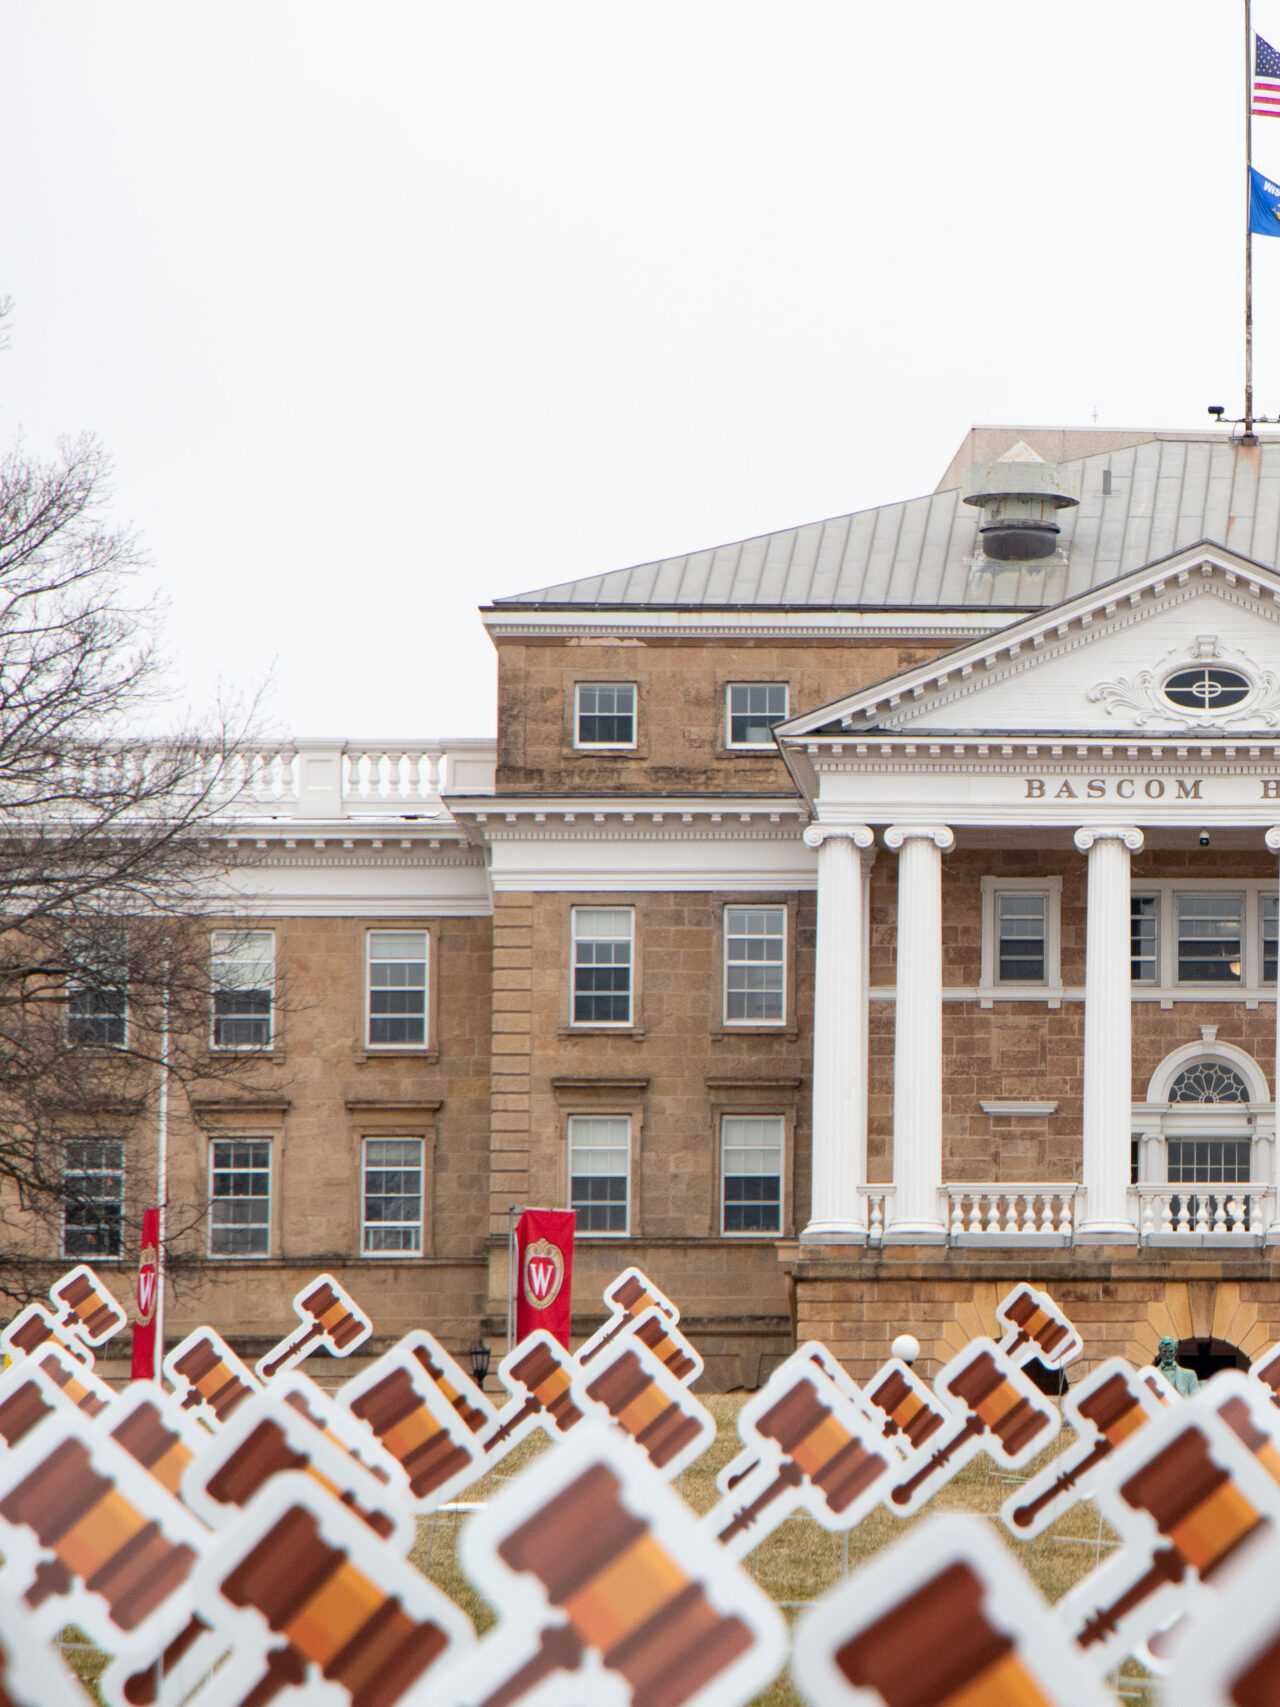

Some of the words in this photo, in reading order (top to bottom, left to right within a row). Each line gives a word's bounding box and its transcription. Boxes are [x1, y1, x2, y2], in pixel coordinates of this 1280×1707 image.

[1024, 779, 1203, 799] BASCOM
[140, 1271, 156, 1310] W
[529, 1262, 554, 1297] W
